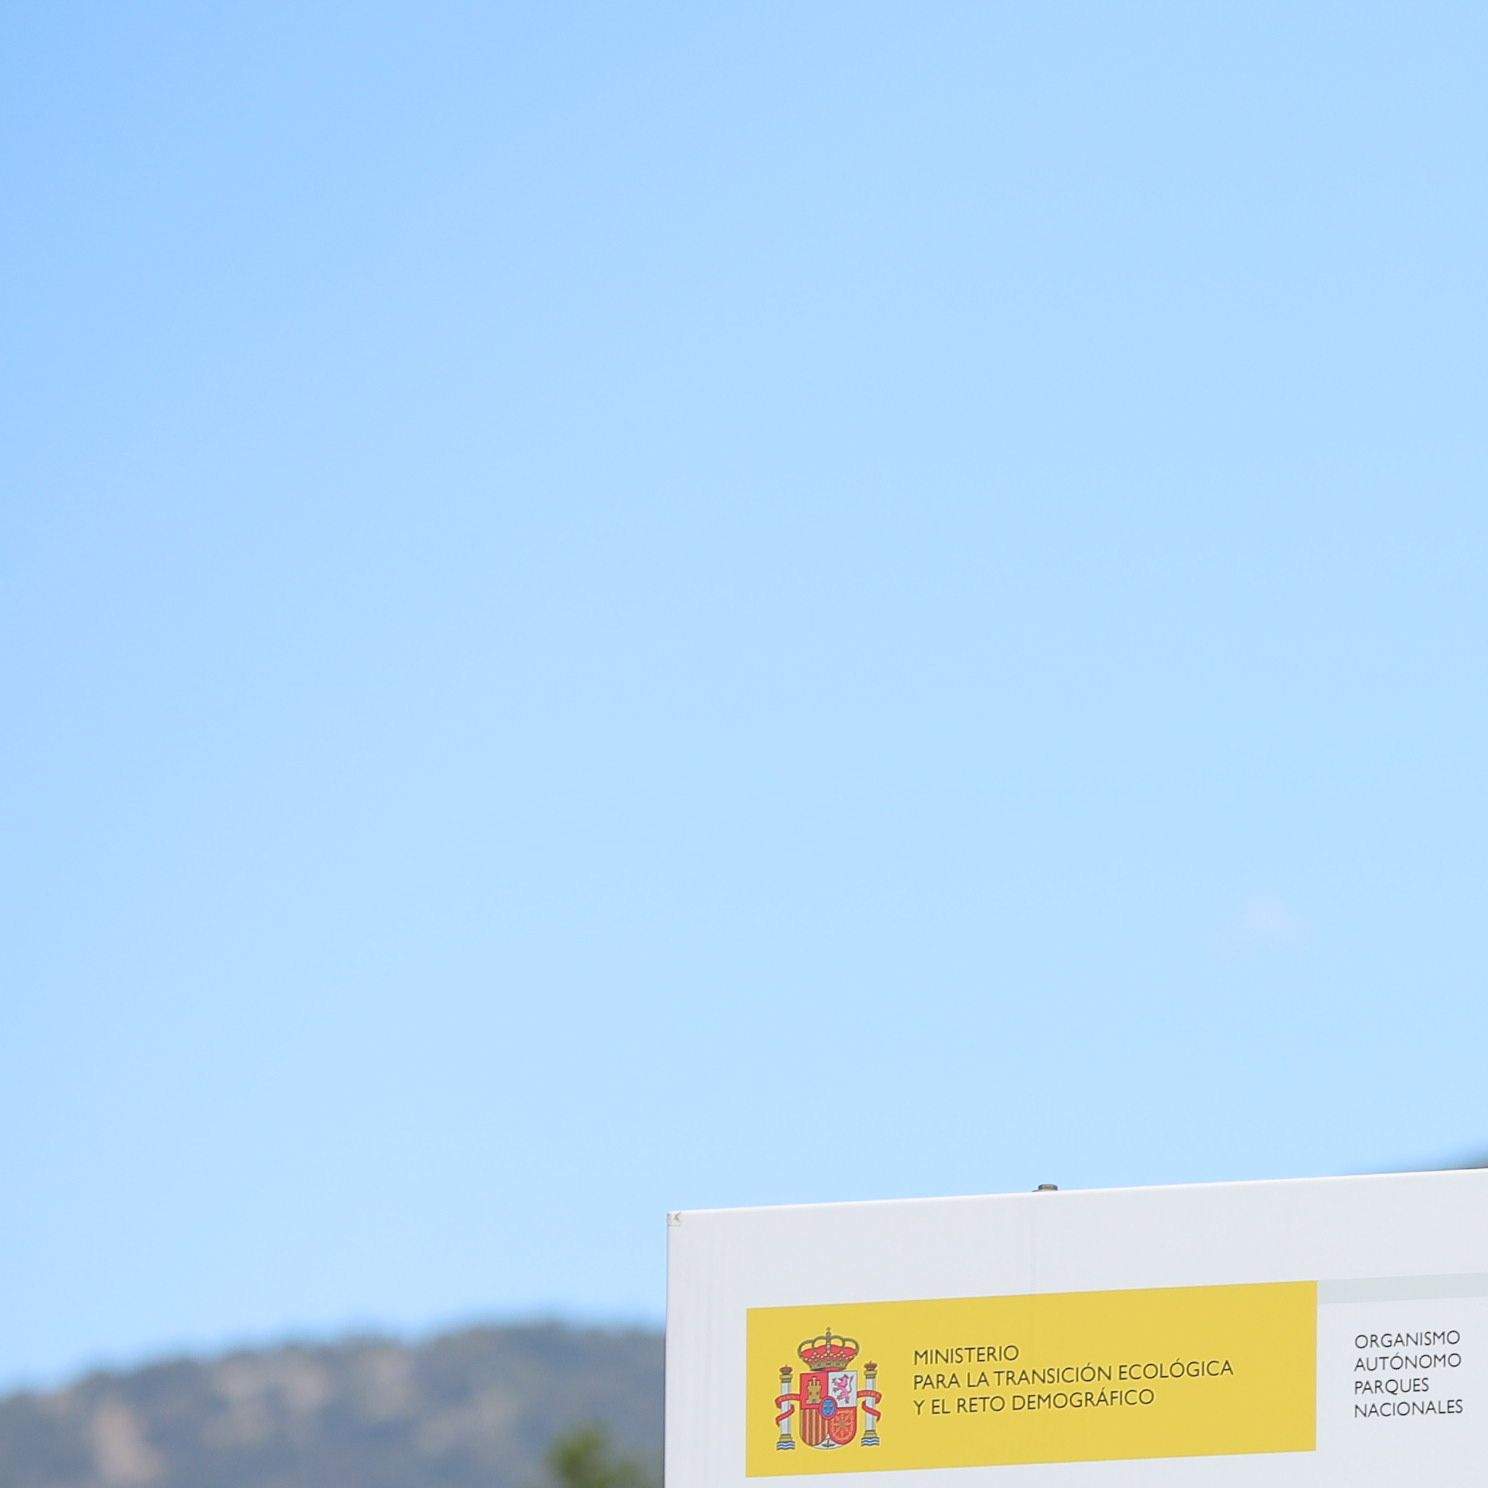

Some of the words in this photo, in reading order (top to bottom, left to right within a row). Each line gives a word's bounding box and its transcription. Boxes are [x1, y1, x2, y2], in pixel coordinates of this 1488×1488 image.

[1354, 1329, 1461, 1350] ORGANISMO
[913, 1344, 1020, 1366] MINISTERIO
[1353, 1351, 1462, 1372] AUTÓNOMO
[913, 1372, 962, 1391] PARA
[966, 1370, 991, 1388] LA
[992, 1361, 1112, 1387] TRANSICIÓN
[1118, 1357, 1234, 1381] ECOLÓGICA
[1354, 1376, 1430, 1396] PARQUES
[913, 1399, 926, 1416] Y
[931, 1398, 952, 1416] EL
[956, 1395, 1006, 1414] RETO
[1011, 1386, 1155, 1411] DEMOGRÁFICO
[1354, 1398, 1464, 1419] NACIONALES
